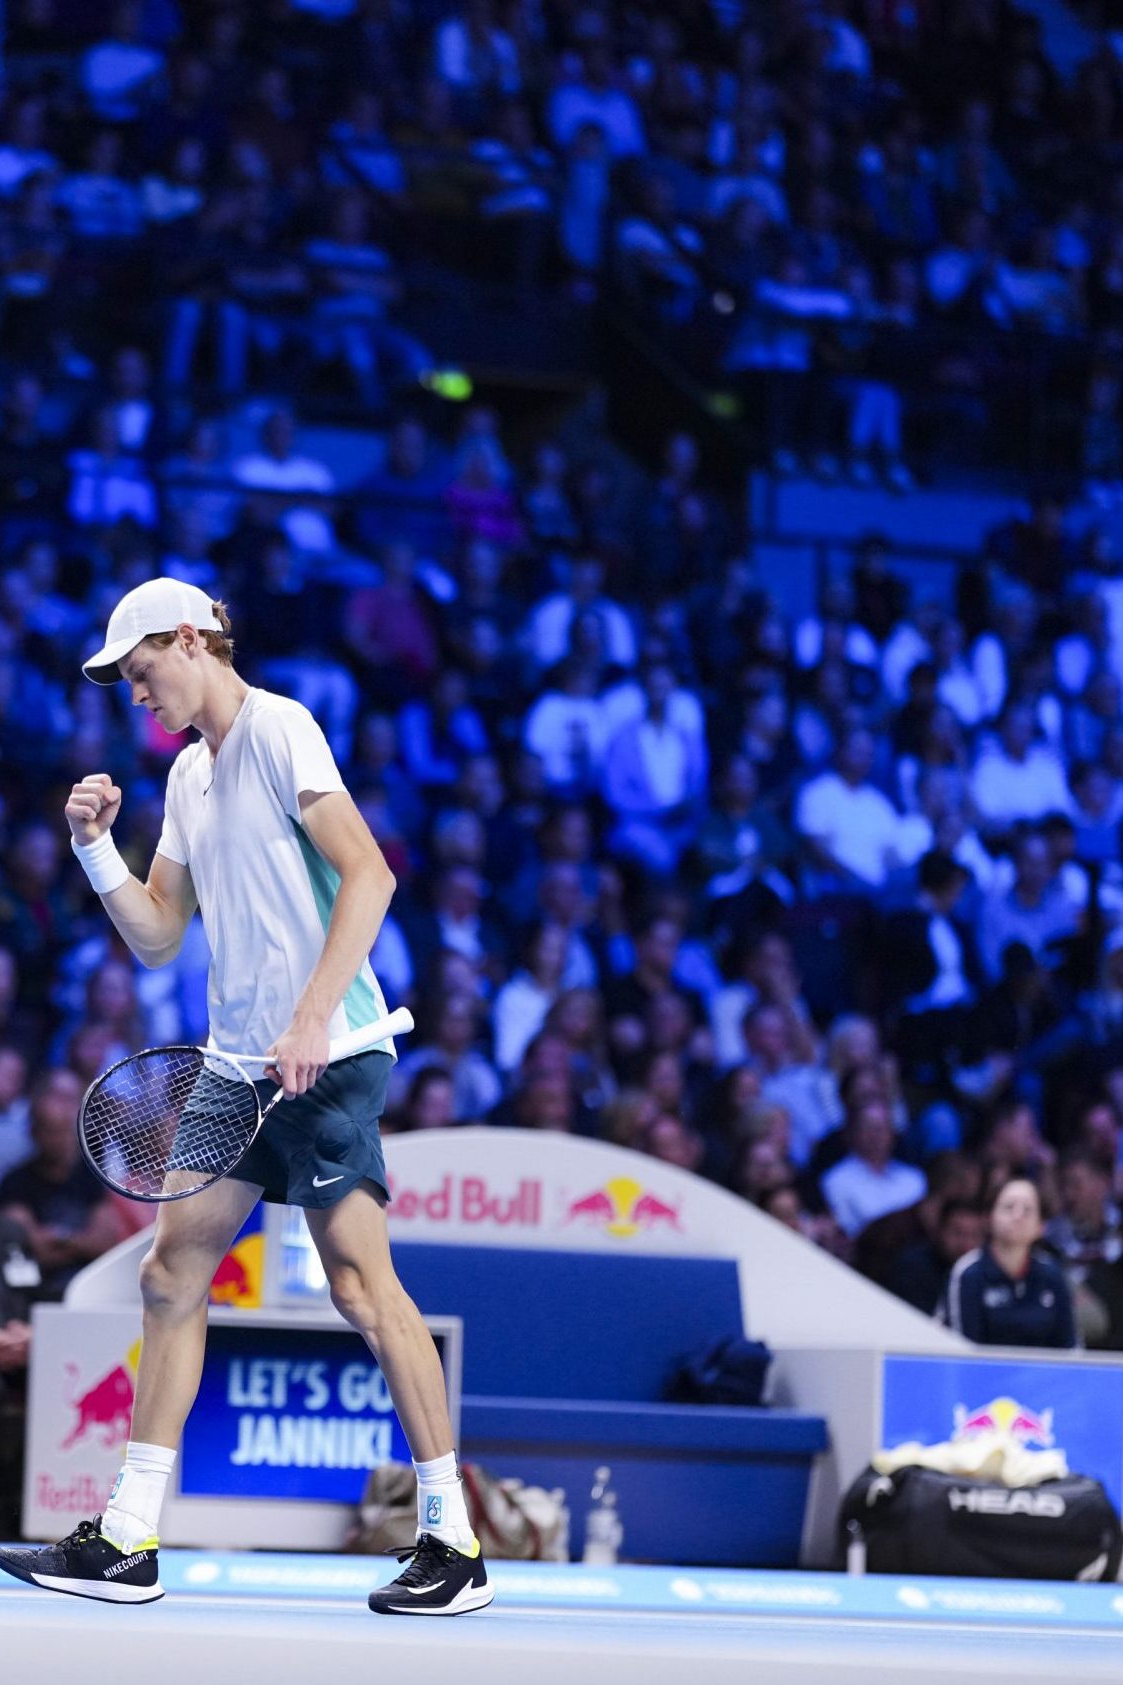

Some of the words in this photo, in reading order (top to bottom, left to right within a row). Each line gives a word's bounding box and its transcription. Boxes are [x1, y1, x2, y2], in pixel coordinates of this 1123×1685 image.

[387, 1171, 452, 1221] ed
[460, 1175, 544, 1226] Bull
[228, 1359, 330, 1411] LET'S
[338, 1362, 394, 1414] GO
[948, 1486, 1067, 1518] HEAD
[103, 1551, 149, 1579] NIKECOURT
